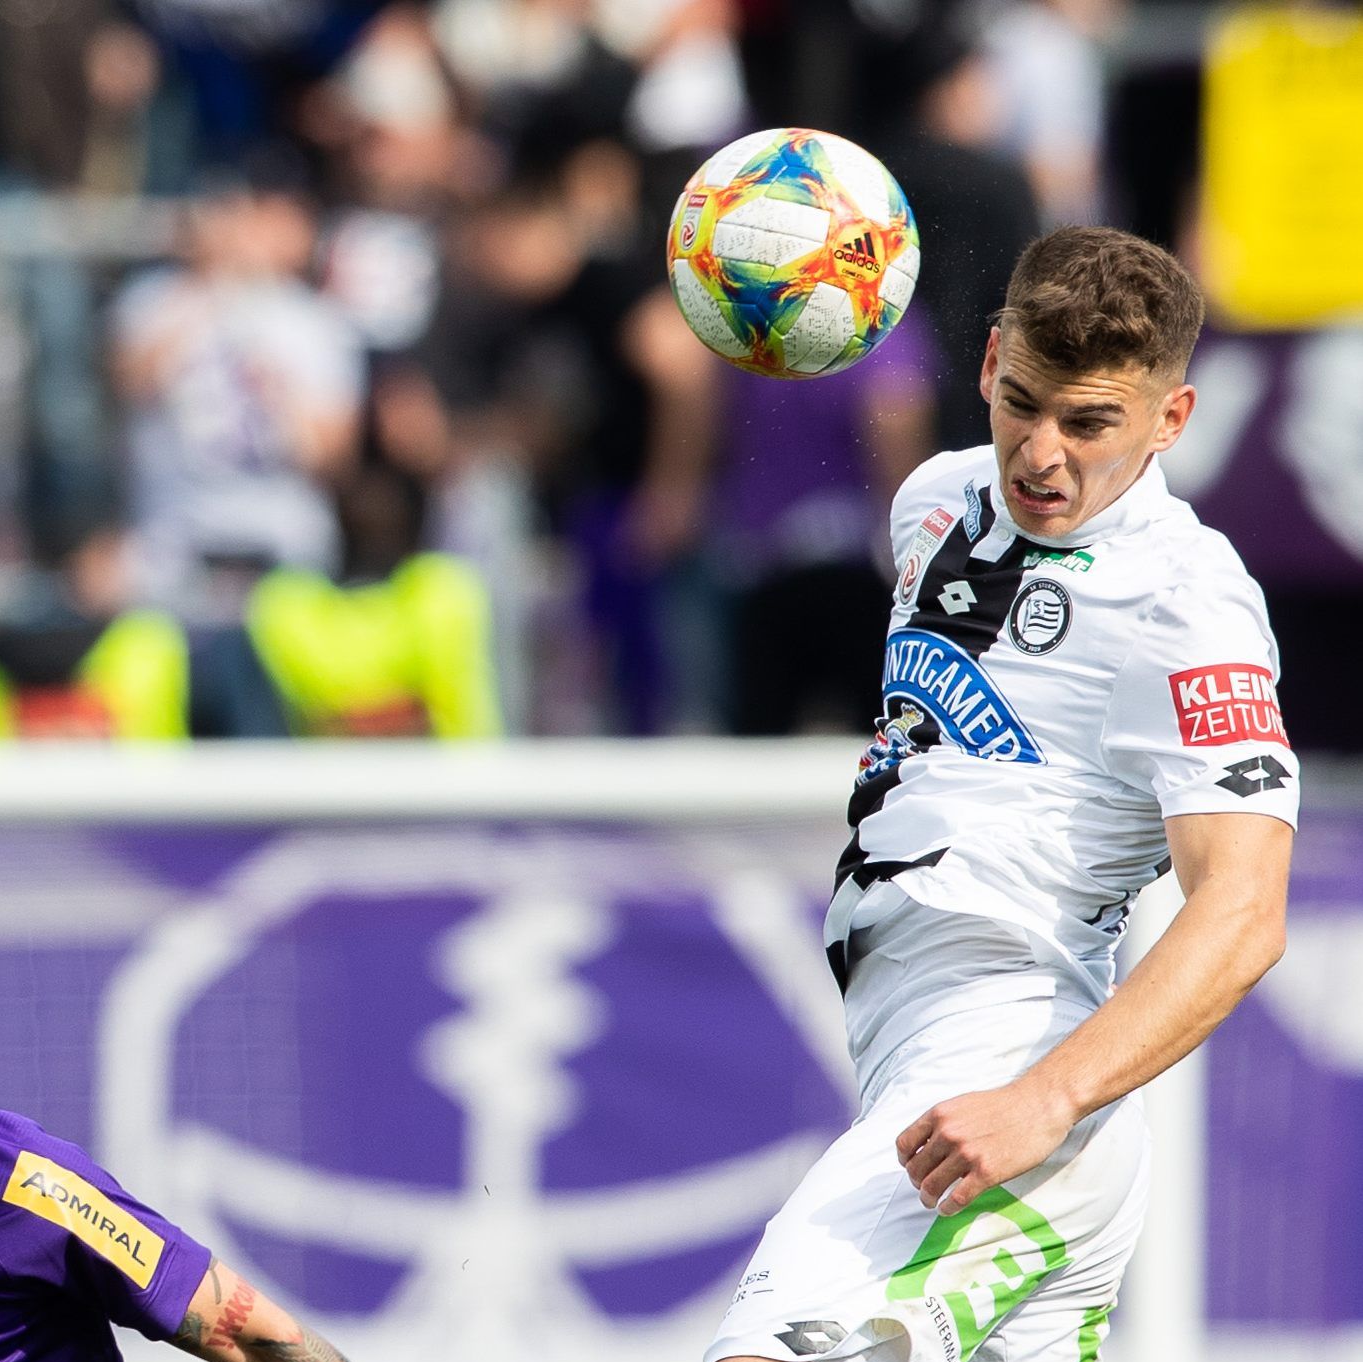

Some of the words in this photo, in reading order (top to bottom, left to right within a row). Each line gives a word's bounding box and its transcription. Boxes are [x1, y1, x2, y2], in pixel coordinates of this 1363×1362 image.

[833, 246, 881, 274] adidas
[885, 640, 1022, 762] NTIGAMER
[1185, 703, 1289, 743] ZEITUN
[19, 1171, 146, 1267] ADMIRAL
